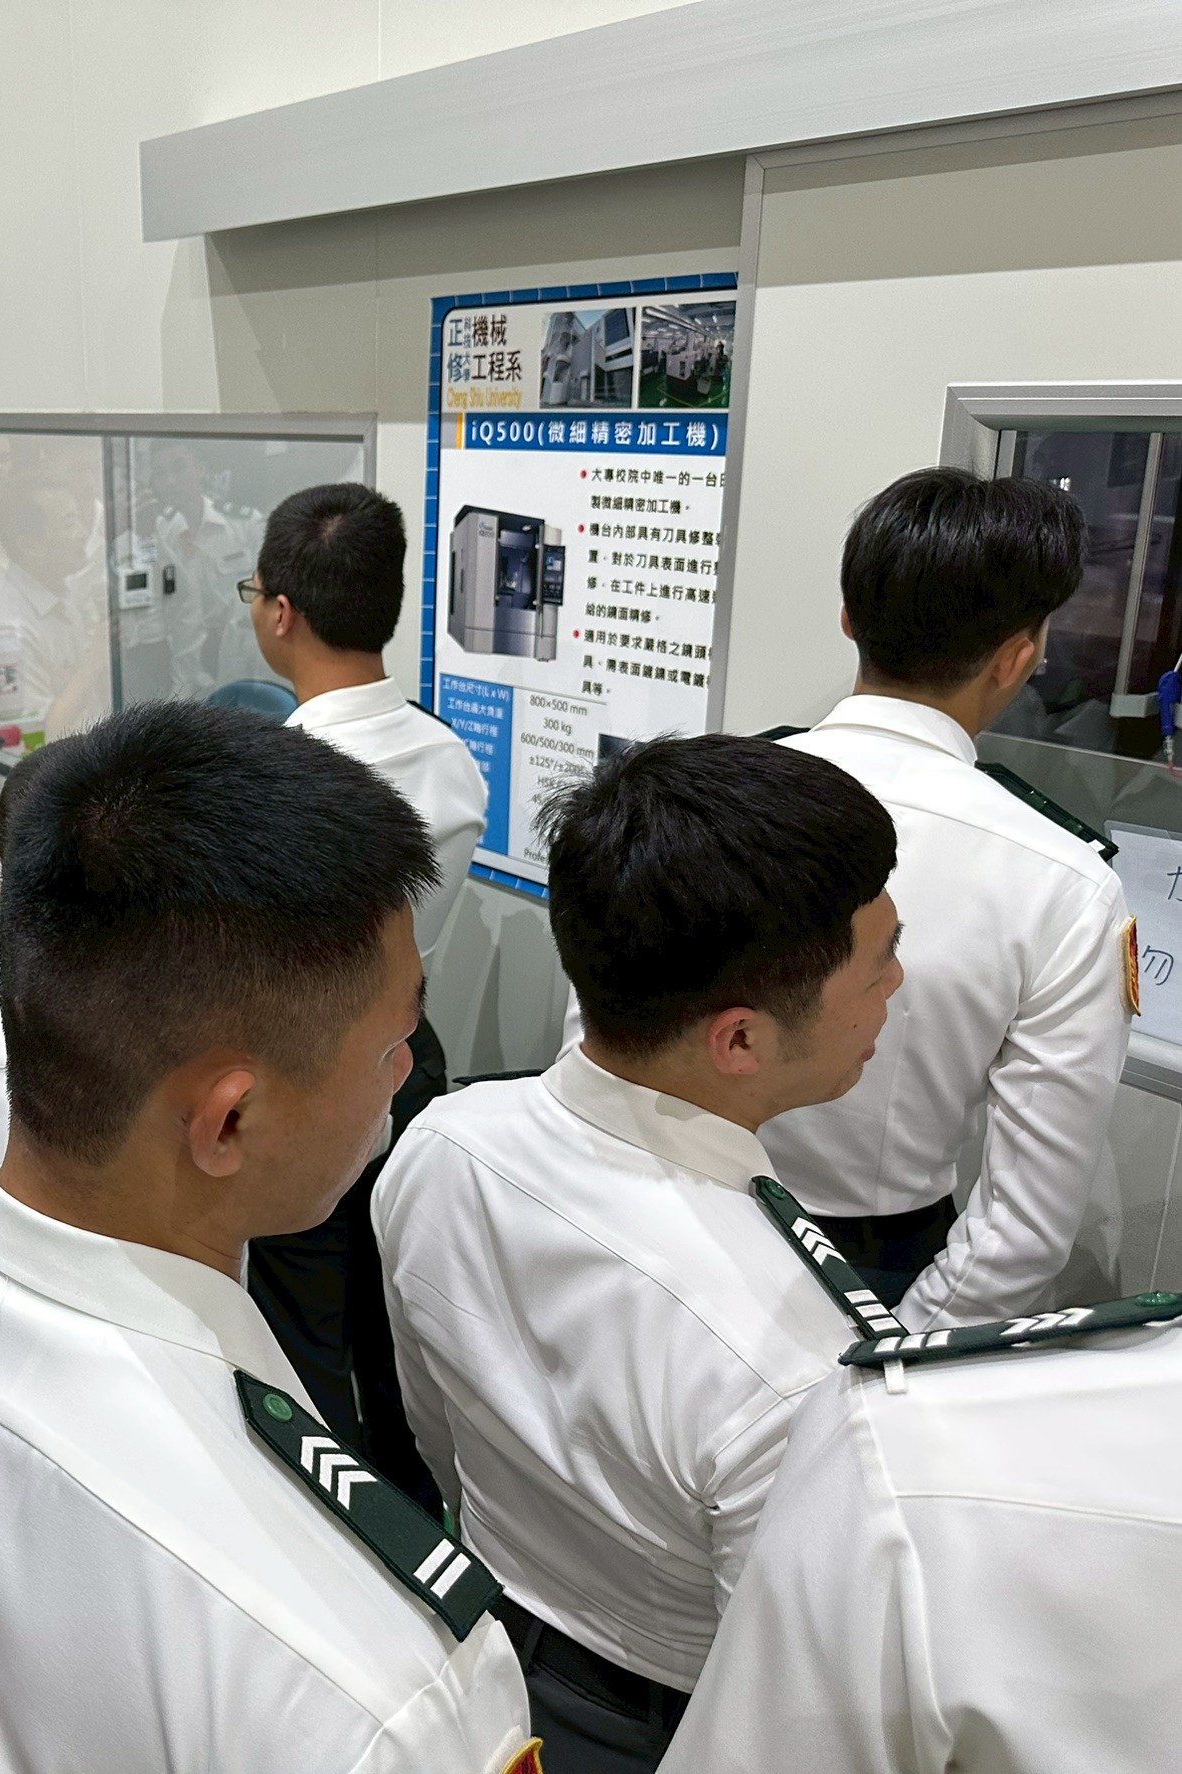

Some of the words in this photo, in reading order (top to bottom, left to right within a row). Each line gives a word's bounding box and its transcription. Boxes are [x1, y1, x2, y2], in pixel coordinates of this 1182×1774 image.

[486, 387, 522, 409] University
[470, 419, 720, 451] iQ500(微細精密加工機)
[584, 629, 712, 661] 適用於要求嚴格之鏡頭
[569, 705, 588, 717] mm
[543, 716, 559, 731] 300
[561, 720, 573, 736] kg
[520, 732, 575, 755] 600/500/300
[576, 747, 595, 759] mm
